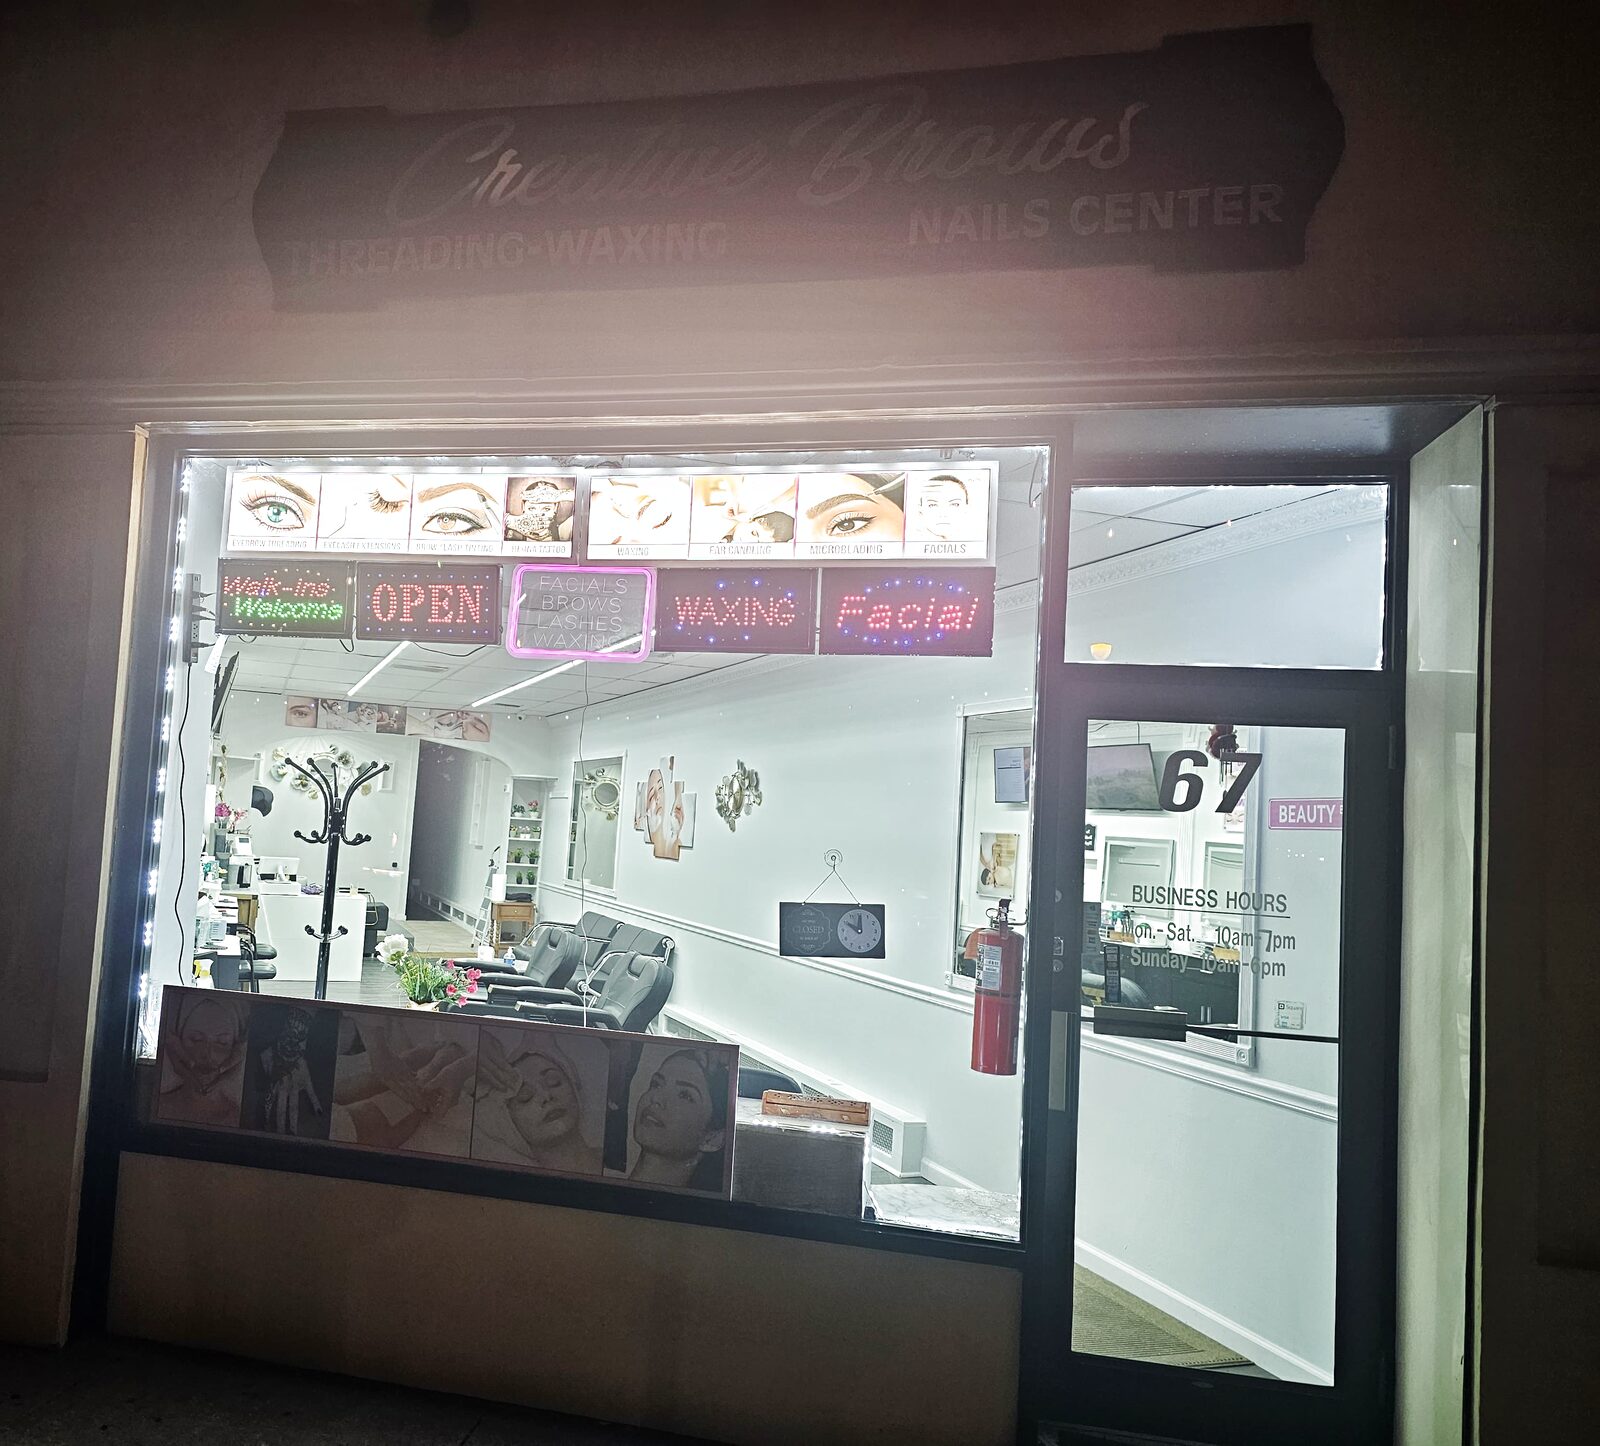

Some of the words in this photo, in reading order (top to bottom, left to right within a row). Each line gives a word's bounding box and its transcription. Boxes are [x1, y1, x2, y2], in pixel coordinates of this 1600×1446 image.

[386, 115, 773, 227] Creative
[788, 84, 1150, 204] Brows
[907, 199, 1051, 246] NAILS
[1069, 182, 1284, 238] CENTER
[924, 544, 967, 554] FACIALS
[223, 576, 330, 597] Walk-ins
[539, 576, 629, 594] FACIALS
[234, 597, 344, 620] Welcome
[371, 583, 484, 623] OPEN
[541, 594, 622, 614] BROWS
[674, 596, 797, 627] WAXING
[836, 595, 979, 630] Facial
[537, 614, 623, 633] LASHES
[1159, 749, 1264, 814] 67
[1279, 804, 1337, 824] BEAUTY
[1132, 885, 1218, 908] BUSINESS
[1226, 890, 1288, 913] HOURS
[1130, 947, 1190, 974] Sunday
